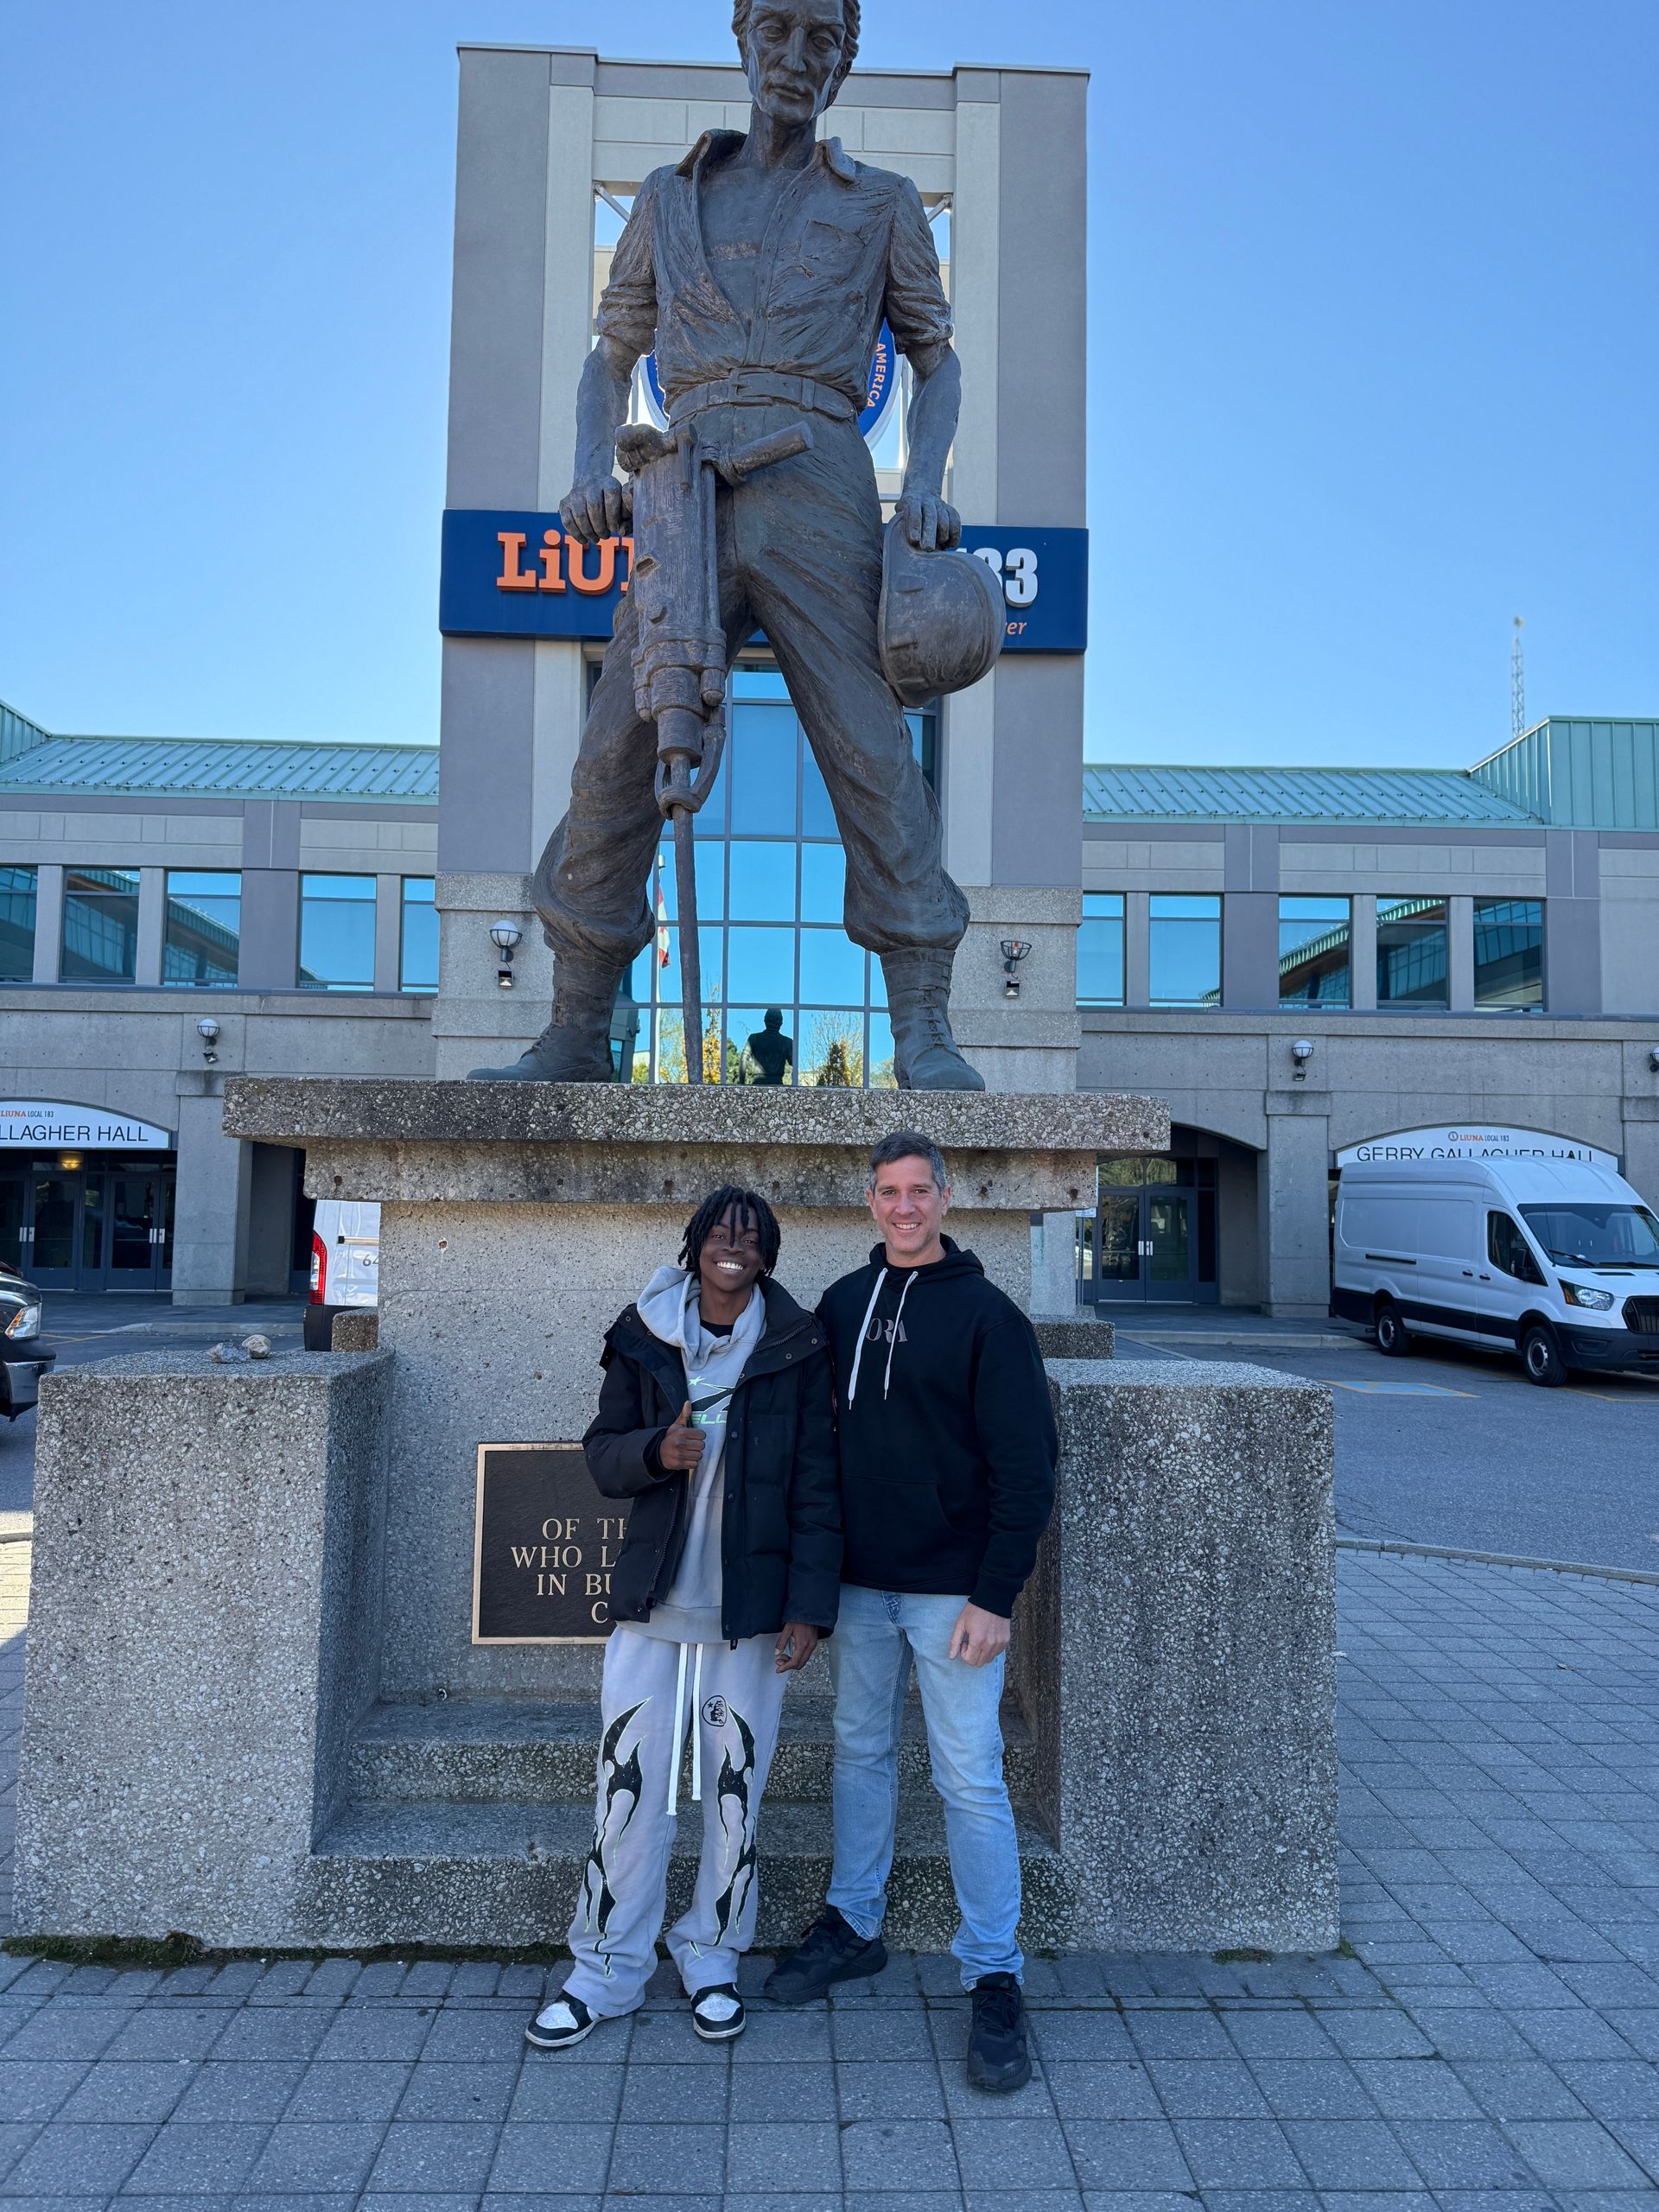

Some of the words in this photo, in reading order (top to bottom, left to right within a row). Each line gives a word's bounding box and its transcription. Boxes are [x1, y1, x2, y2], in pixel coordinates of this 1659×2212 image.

[867, 342, 887, 408] AMERICA
[98, 1126, 149, 1141] HALL
[1357, 1147, 1425, 1161] GERRY
[542, 1518, 580, 1540] OF
[511, 1545, 582, 1568] WHO
[601, 1545, 622, 1567] L
[537, 1573, 568, 1596] IN
